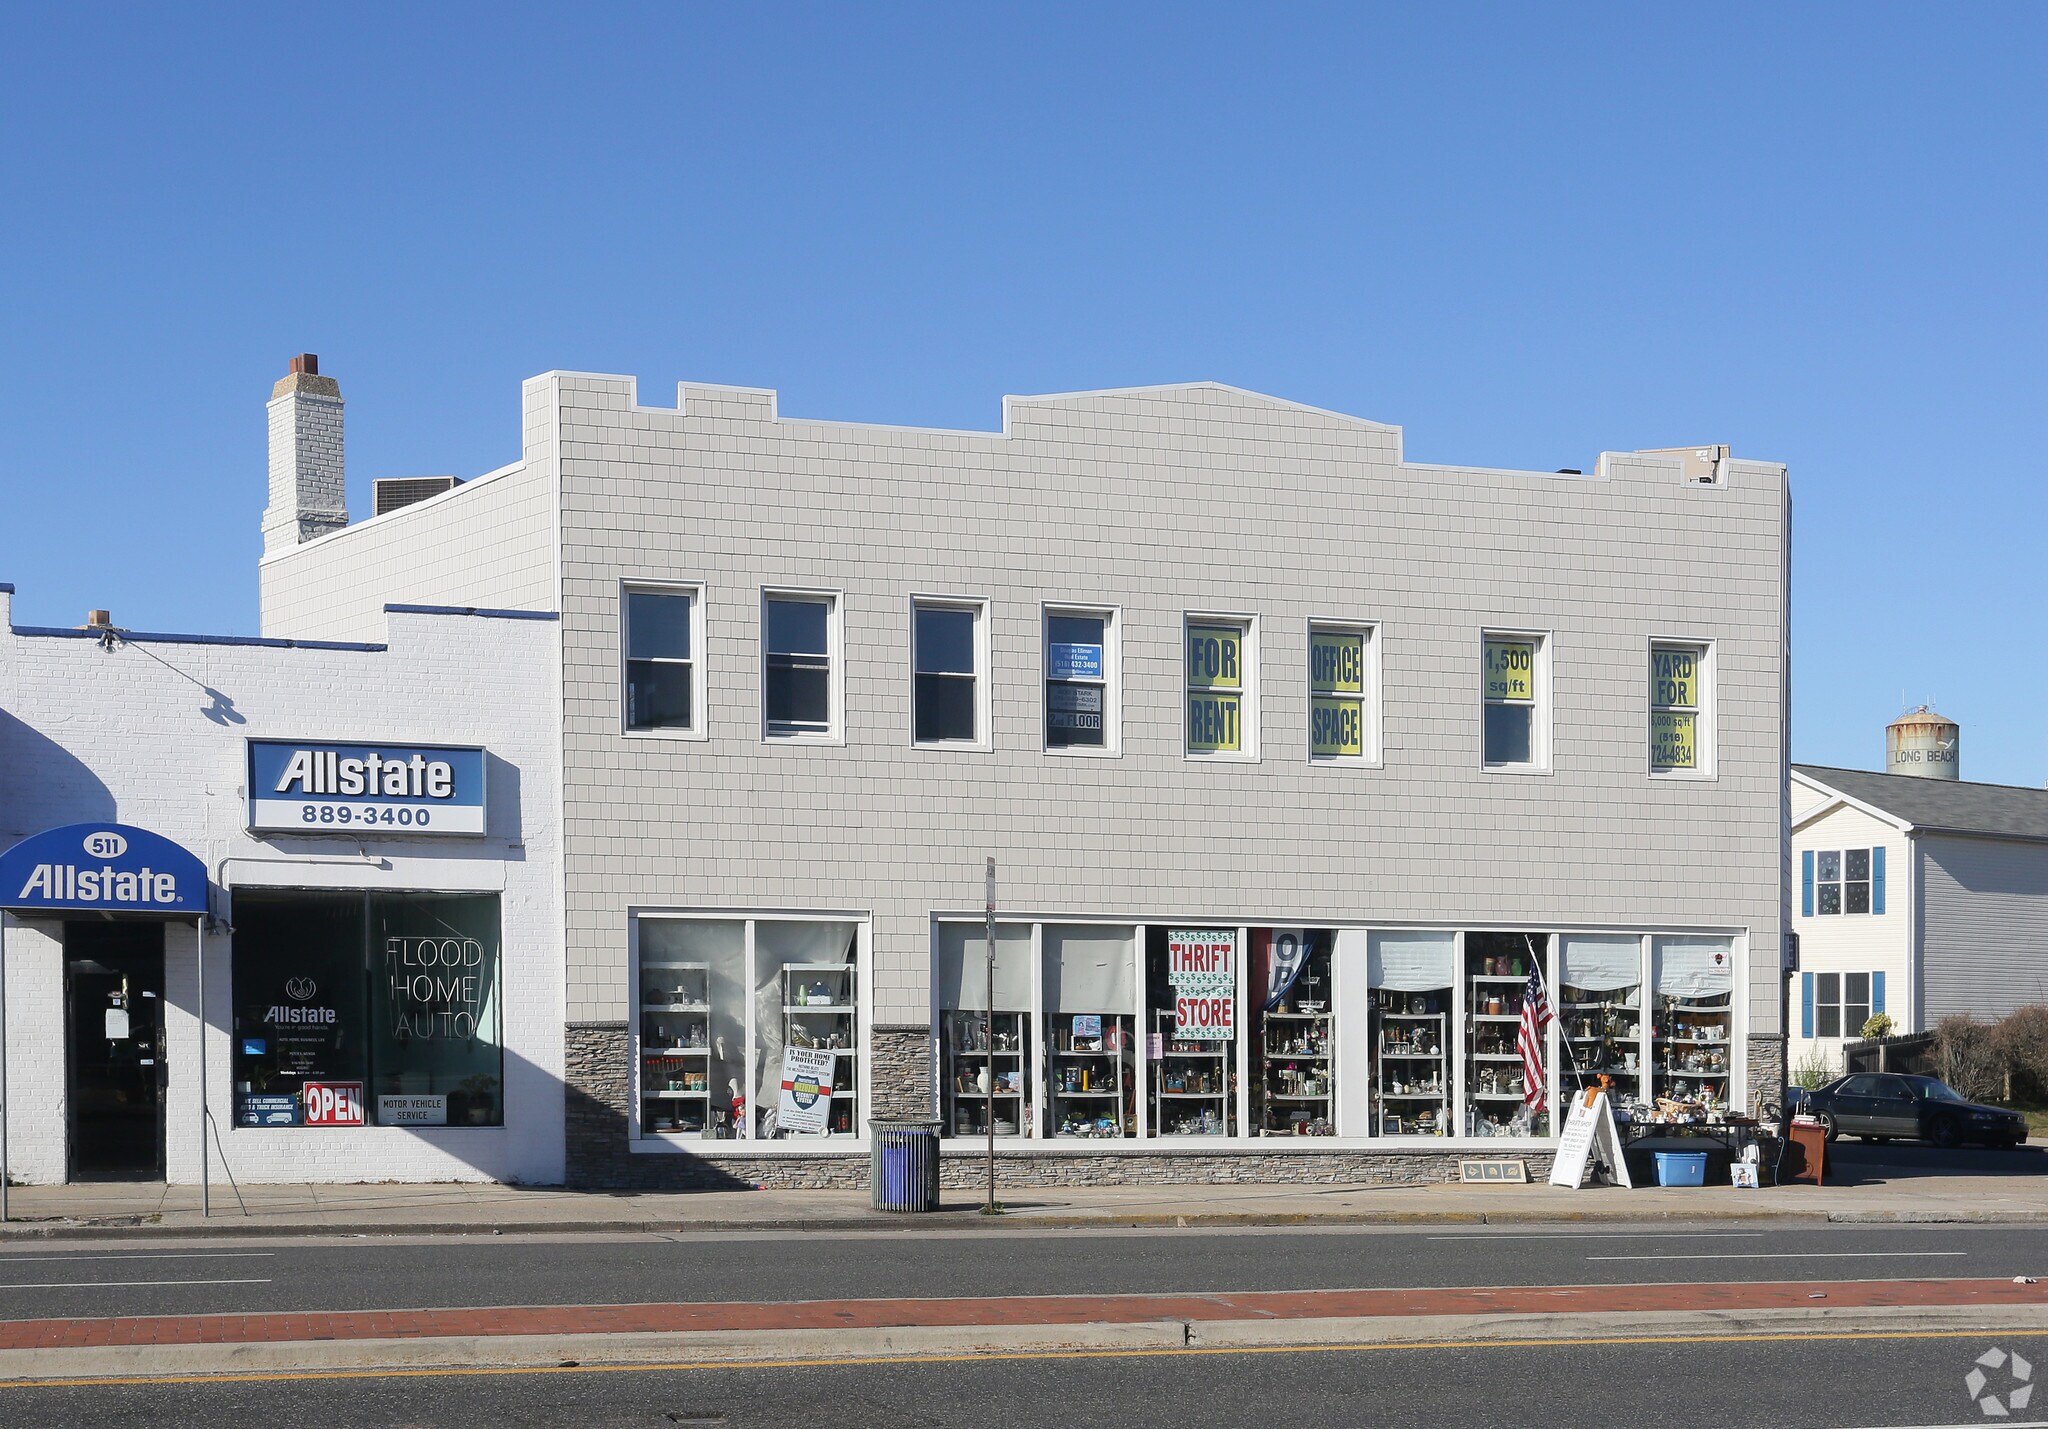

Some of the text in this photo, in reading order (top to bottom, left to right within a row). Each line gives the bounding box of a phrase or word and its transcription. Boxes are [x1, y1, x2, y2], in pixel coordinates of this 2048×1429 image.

[1192, 637, 1237, 679] FOR
[1312, 644, 1360, 683] OFFICE
[1484, 649, 1530, 674] 1,500
[1653, 655, 1692, 679] YARD
[1490, 679, 1525, 694] sq/ft
[1657, 681, 1688, 704] FOR
[1067, 714, 1100, 728] FLOOR
[1191, 700, 1236, 745] RENT
[1312, 708, 1358, 747] SPACE
[1651, 745, 1692, 763] 724-4834
[1896, 750, 1955, 763] LONG BEACH
[275, 751, 452, 798] Allstate
[302, 805, 430, 826] 889-3400
[92, 838, 119, 853] 511
[18, 863, 177, 903] Allstate
[387, 939, 482, 967] FLOOD
[1169, 943, 1231, 972] THRIFT
[391, 975, 477, 1003] HOME
[263, 1005, 336, 1023] Allstate
[1177, 997, 1232, 1027] STORE
[394, 1011, 475, 1039] AUTO
[790, 1055, 829, 1067] PROTECTED?
[796, 1050, 813, 1059] YOUR
[814, 1053, 831, 1061] HOME
[307, 1087, 362, 1121] OPEN
[383, 1100, 441, 1109] MOTOR VEHICLE
[397, 1111, 427, 1120] SERVICE
